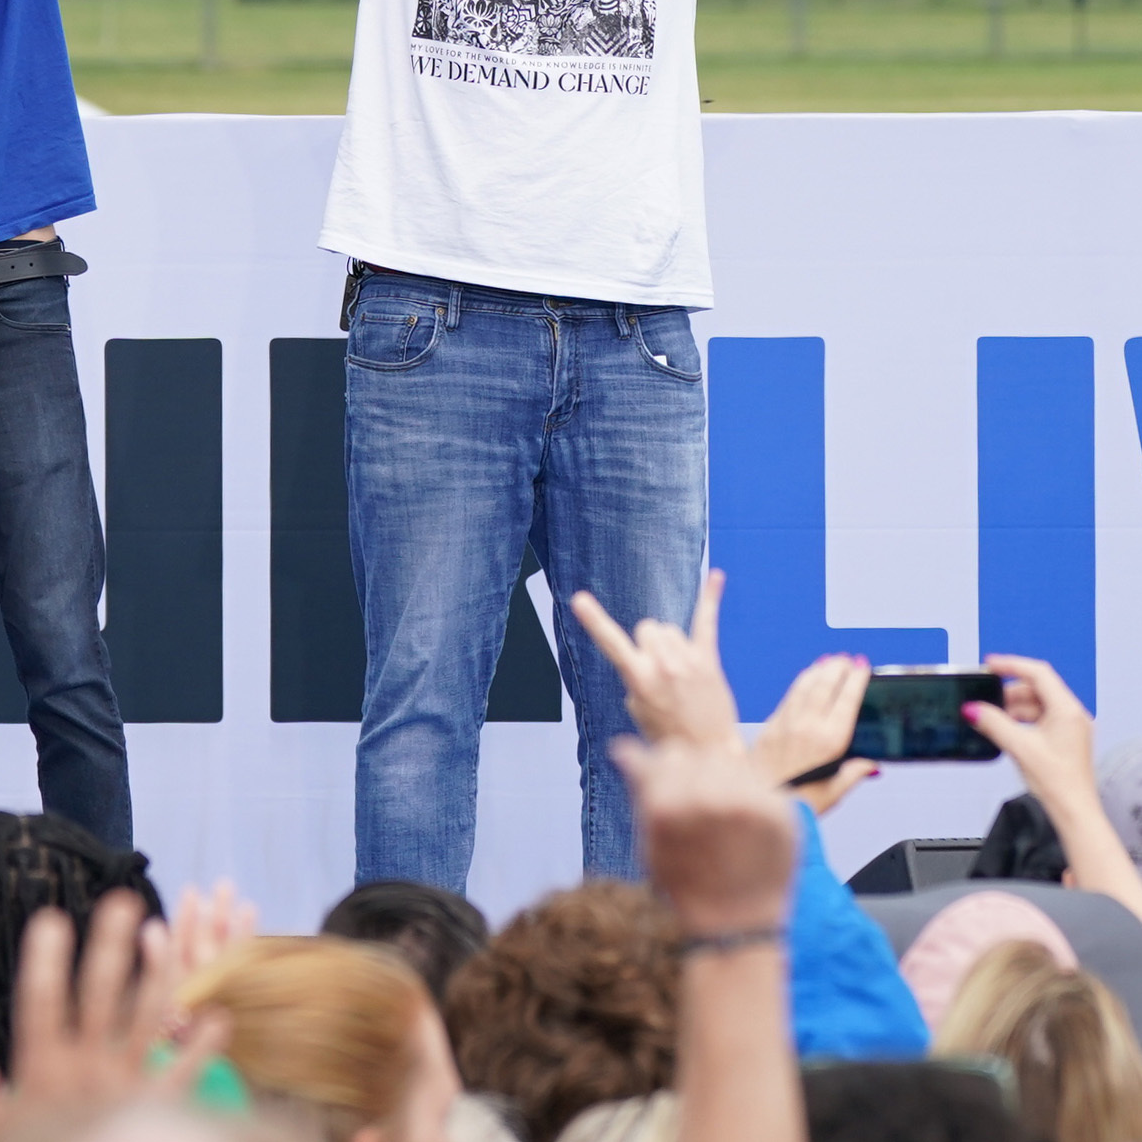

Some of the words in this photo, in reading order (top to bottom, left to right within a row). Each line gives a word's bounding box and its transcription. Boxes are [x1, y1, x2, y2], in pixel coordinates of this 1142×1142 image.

[410, 43, 422, 51] MY
[425, 45, 444, 56] LOVE
[446, 49, 462, 59] FOR
[466, 51, 482, 61] THE
[484, 54, 517, 66] WORLD
[546, 61, 605, 70] KNOWLEDGE
[609, 62, 616, 70] IS
[619, 62, 652, 73] INFINITE
[410, 54, 442, 78] WE
[448, 60, 550, 90] DEMAND
[558, 72, 651, 96] CHANGE
[708, 336, 1142, 724] LI
